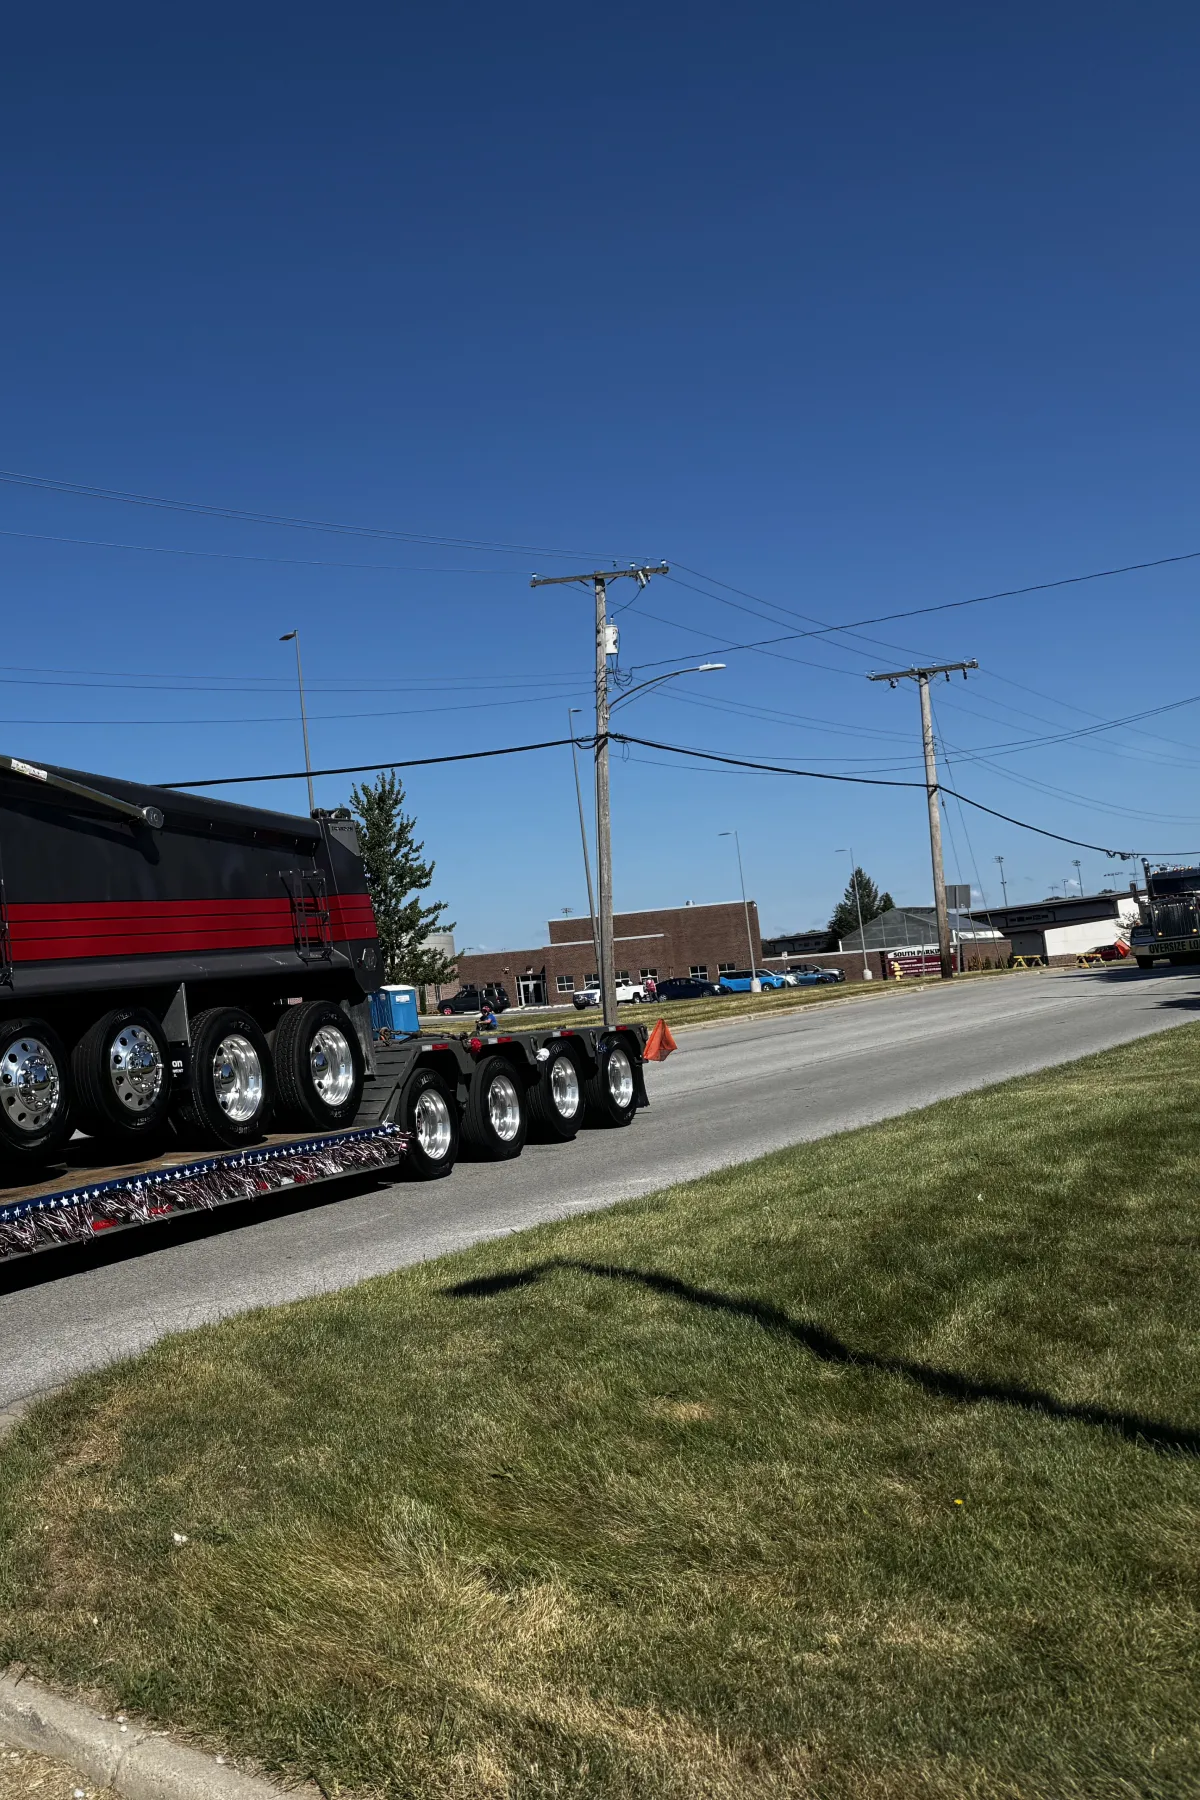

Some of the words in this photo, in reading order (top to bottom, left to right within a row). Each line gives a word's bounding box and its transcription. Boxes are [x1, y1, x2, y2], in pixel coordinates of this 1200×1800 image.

[893, 950, 916, 958] SOUTH
[916, 948, 940, 956] PARKIN
[1149, 942, 1187, 955] OVERSIZE
